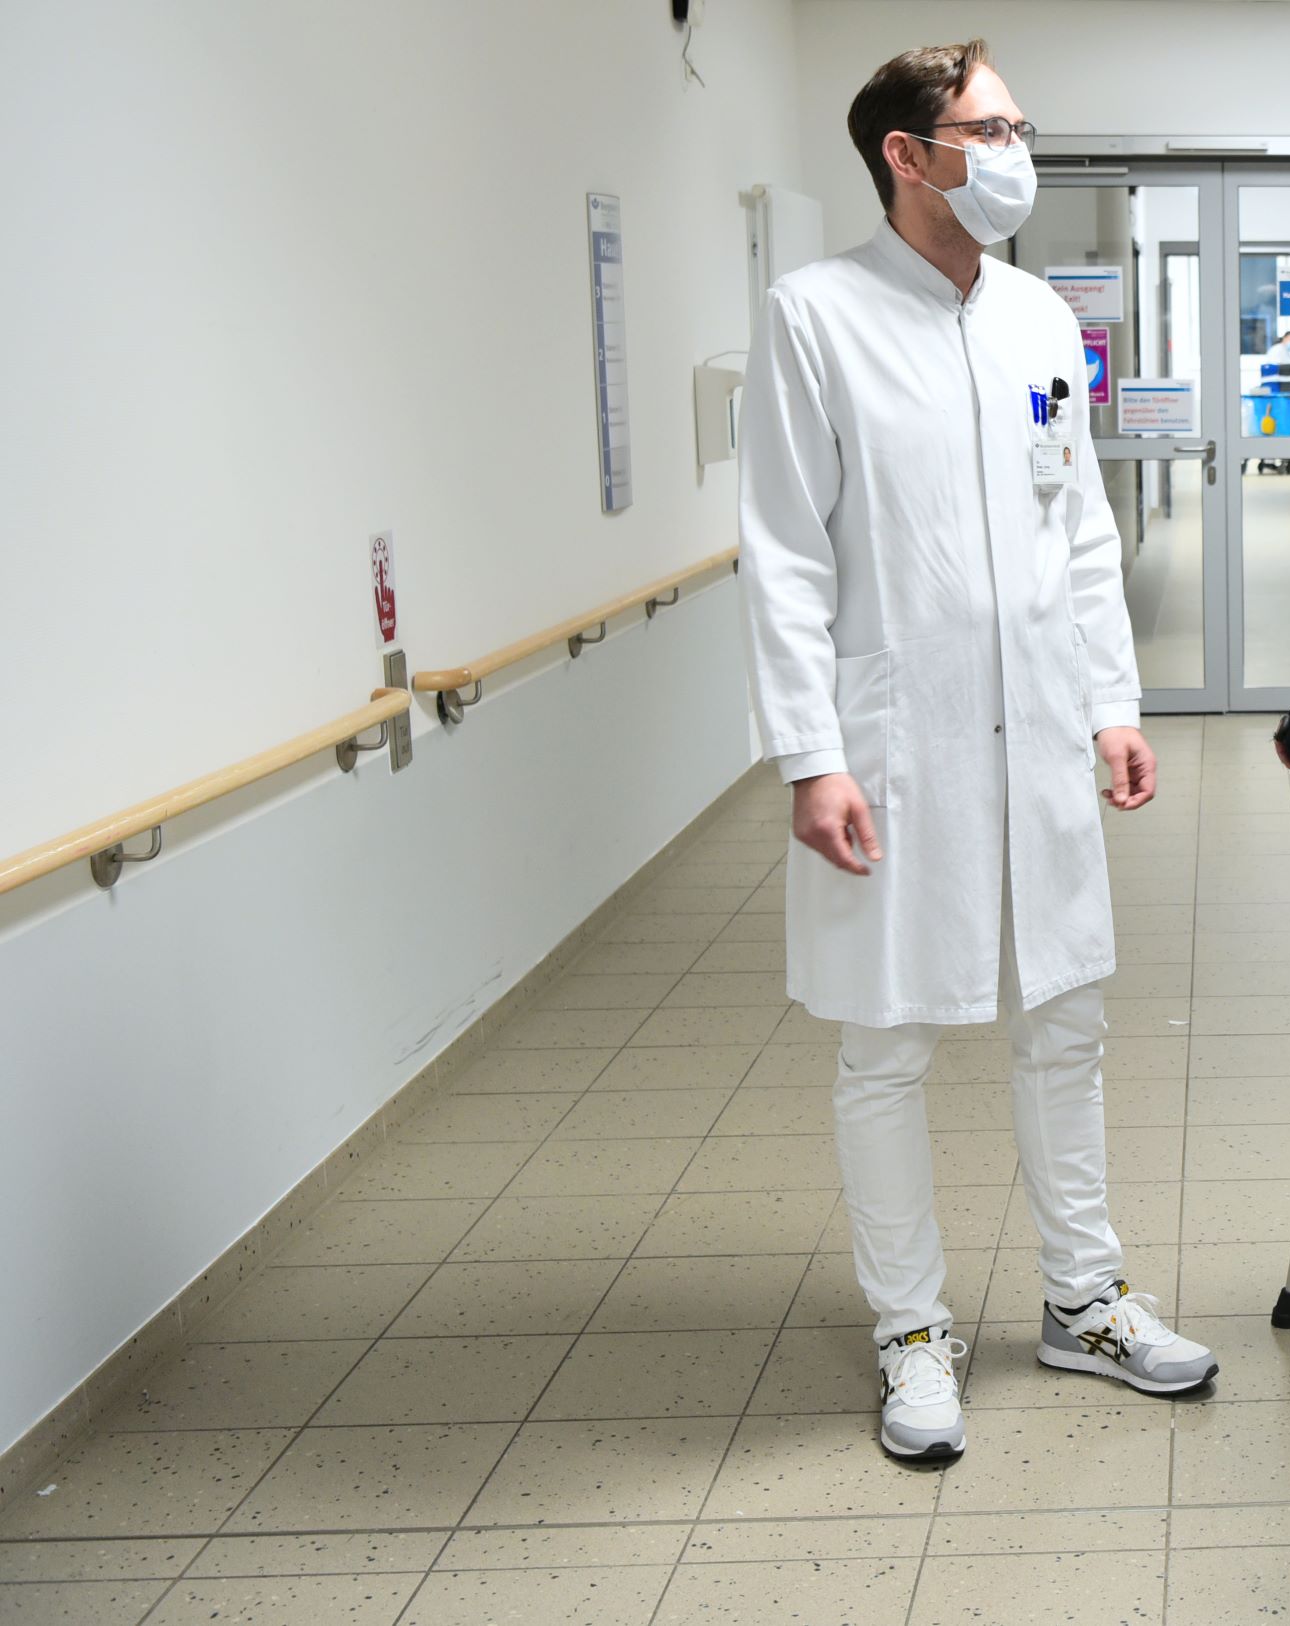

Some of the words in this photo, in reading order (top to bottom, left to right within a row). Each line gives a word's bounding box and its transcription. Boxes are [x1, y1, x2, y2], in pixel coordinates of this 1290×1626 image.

[594, 286, 601, 298] 3
[1071, 285, 1104, 293] Ausgang!
[598, 349, 604, 360] 2
[605, 475, 610, 487] 0
